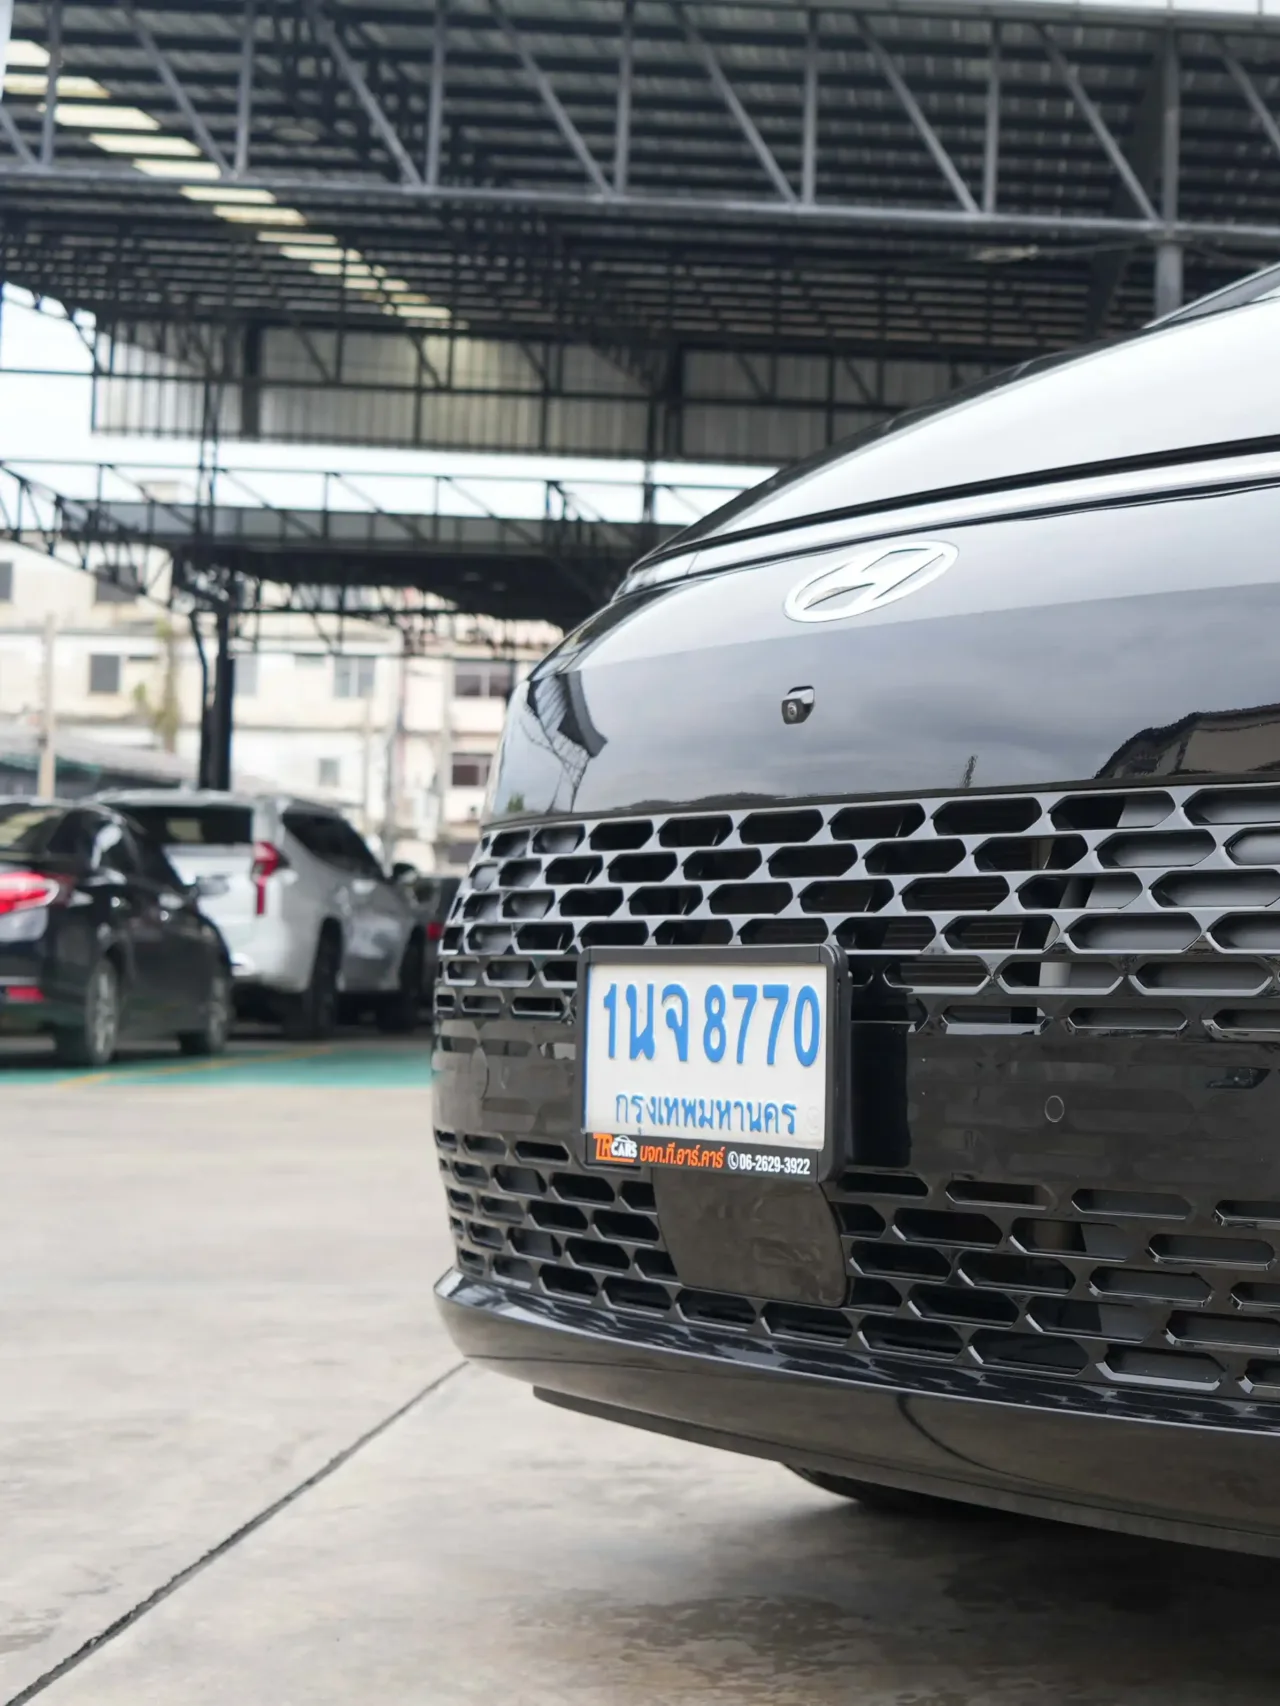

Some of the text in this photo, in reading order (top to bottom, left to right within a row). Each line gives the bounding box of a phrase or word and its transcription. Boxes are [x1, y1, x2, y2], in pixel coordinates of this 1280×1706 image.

[603, 983, 821, 1067] 1นจ 8770
[615, 1094, 797, 1135] กรุงเทพมหานคร
[611, 1140, 637, 1158] CARS
[739, 1154, 811, 1175] 06-2629-3922
